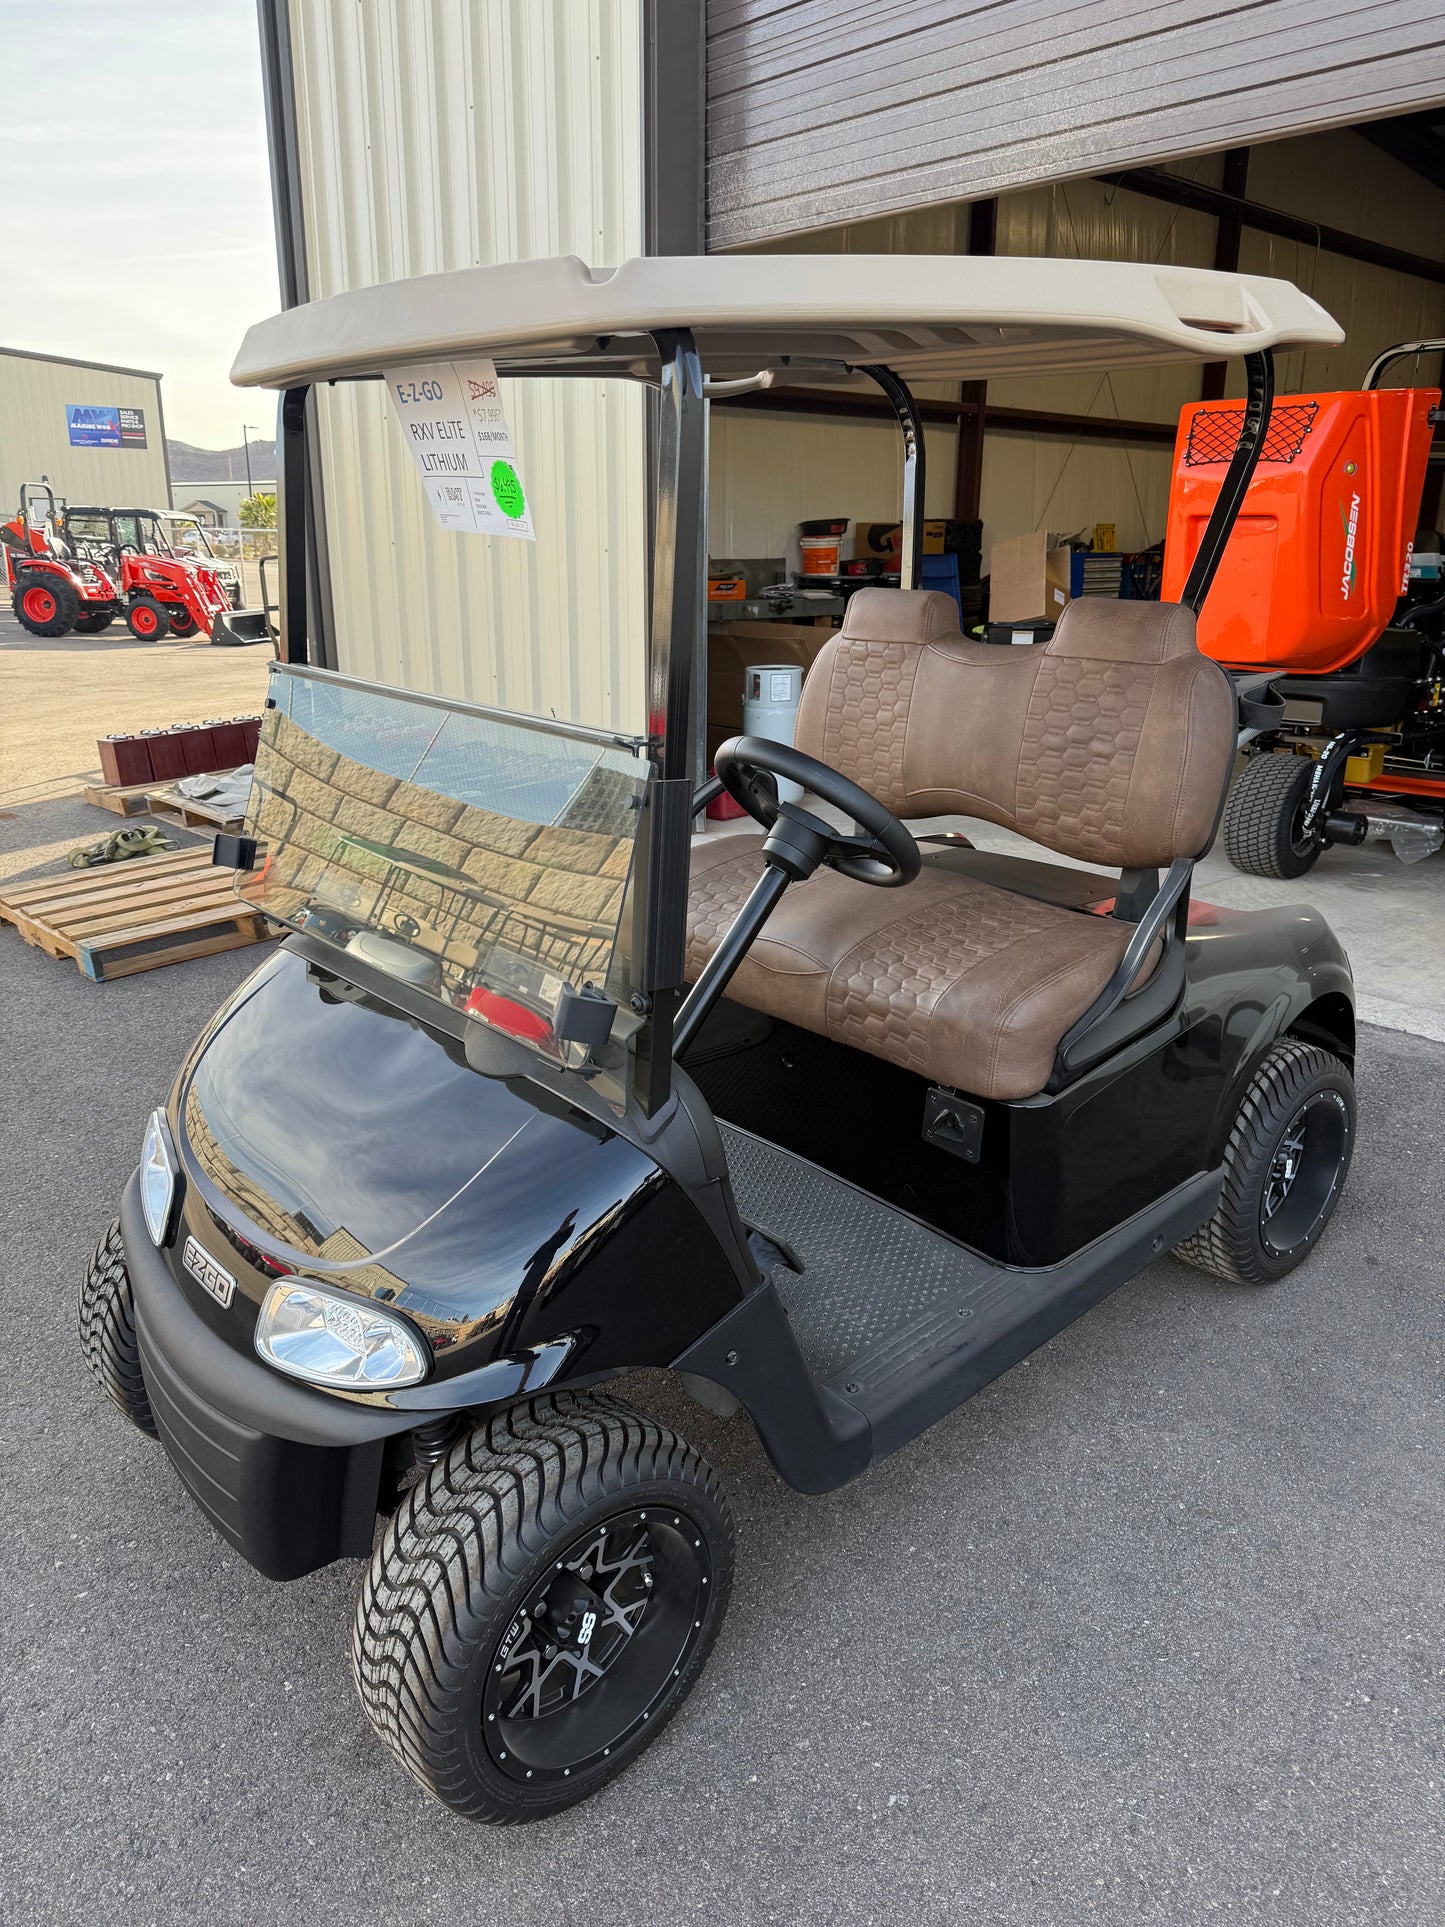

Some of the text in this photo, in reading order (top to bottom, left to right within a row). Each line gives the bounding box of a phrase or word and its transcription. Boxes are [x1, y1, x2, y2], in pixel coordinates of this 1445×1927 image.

[396, 380, 443, 404] E-Z-GO
[410, 422, 435, 441] RXV
[421, 453, 469, 471] LITHIUM
[1341, 493, 1361, 600] JACOBSEN
[1401, 541, 1414, 593] TR320
[184, 1243, 230, 1302] EZGO
[500, 1622, 520, 1659] GTW
[577, 1612, 597, 1645] SS
